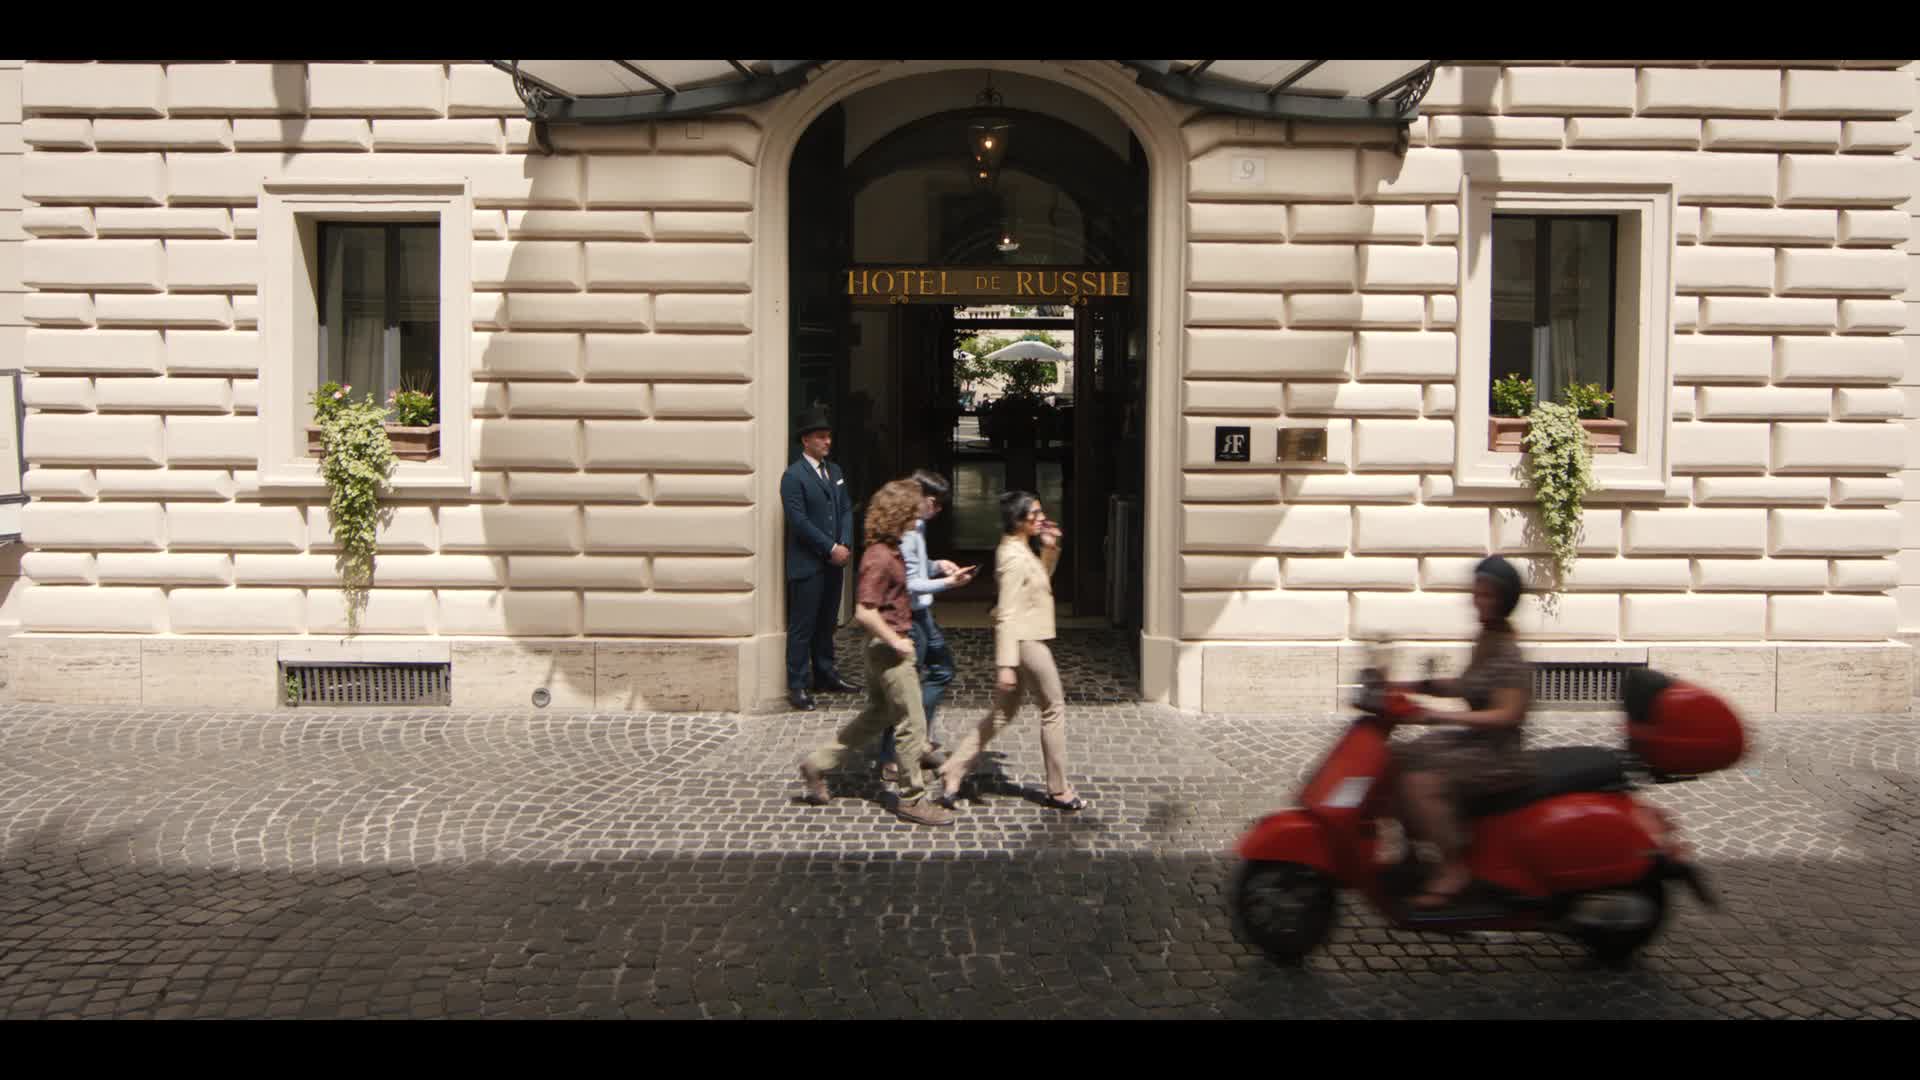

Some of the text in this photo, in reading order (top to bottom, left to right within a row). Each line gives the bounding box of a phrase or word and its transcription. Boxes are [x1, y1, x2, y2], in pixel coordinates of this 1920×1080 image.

[1241, 159, 1256, 179] 9
[848, 271, 1129, 296] HOTEL DE RUSSIE
